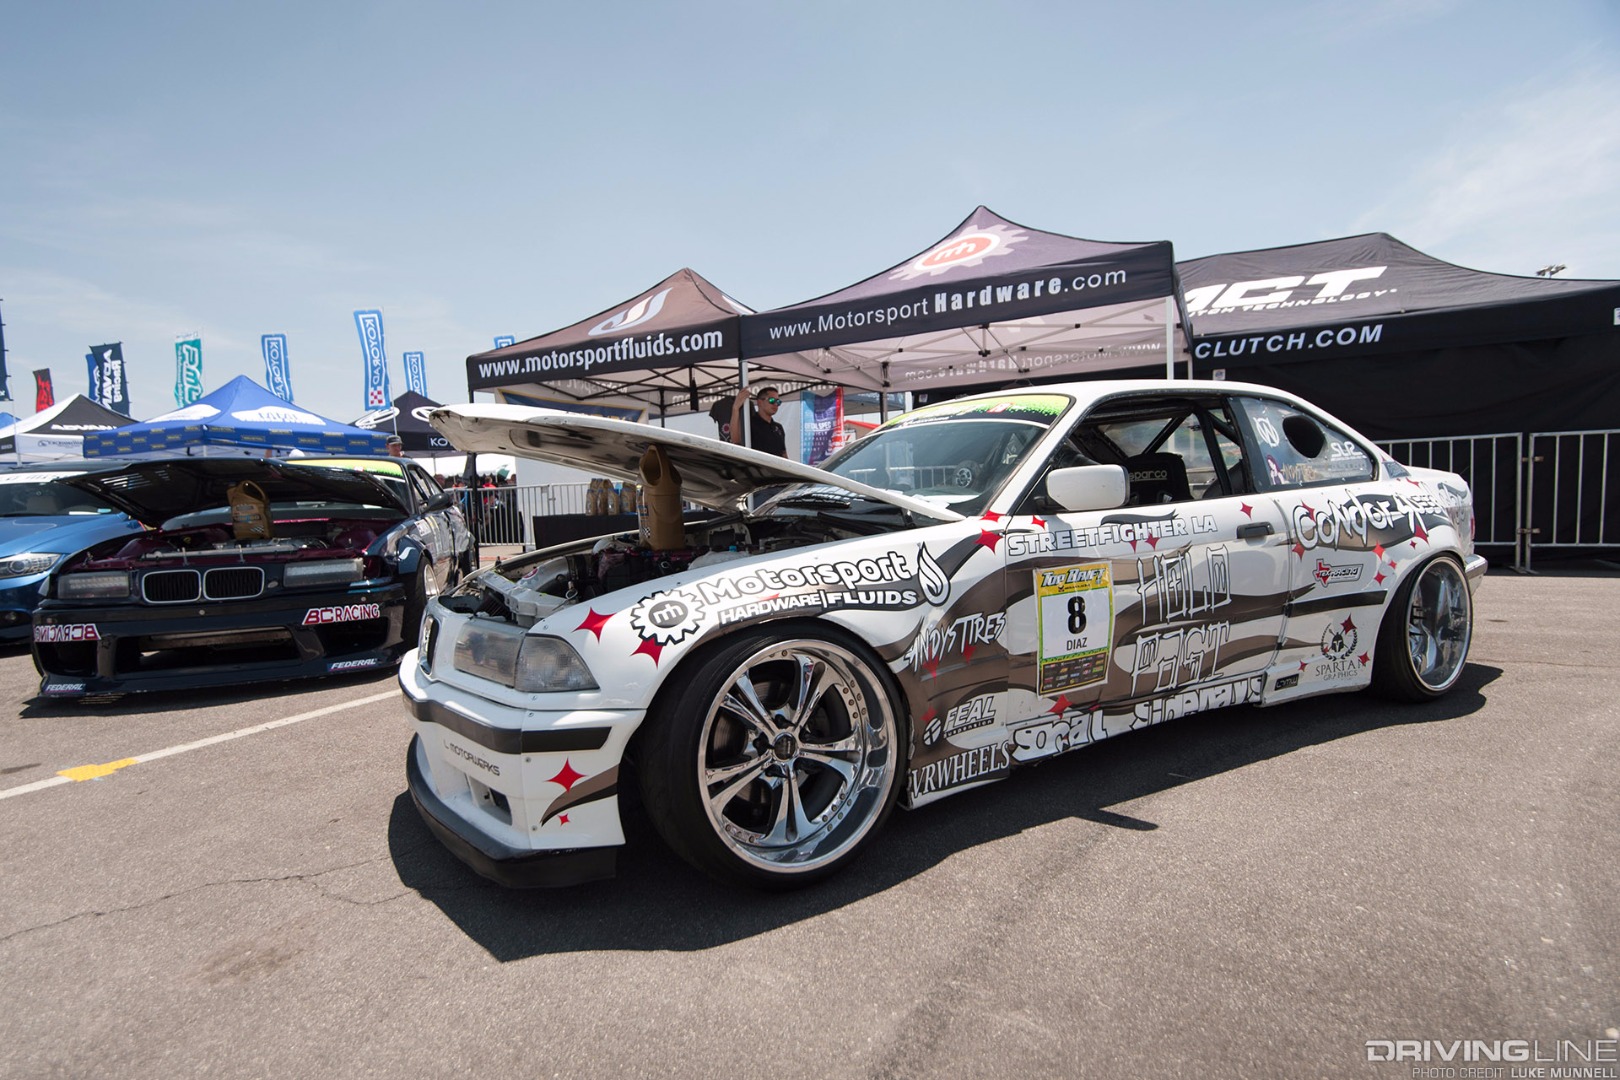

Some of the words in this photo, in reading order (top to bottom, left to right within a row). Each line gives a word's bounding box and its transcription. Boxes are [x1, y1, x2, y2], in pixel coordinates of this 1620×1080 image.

[478, 329, 723, 378] www.motorsportfluids.com
[1194, 323, 1384, 359] CLUTCH.COM
[1007, 517, 1189, 556] STREETFIGHTER
[1191, 514, 1219, 535] LA
[697, 551, 913, 605] Motorsport
[718, 592, 821, 628] HARDWARE
[825, 590, 918, 606] FLUIDS
[1067, 595, 1087, 634] 8
[1066, 637, 1088, 651] DIAZ
[331, 658, 377, 670] FEDERAL
[46, 683, 85, 691] FEDERAL
[943, 696, 996, 733] FEAL
